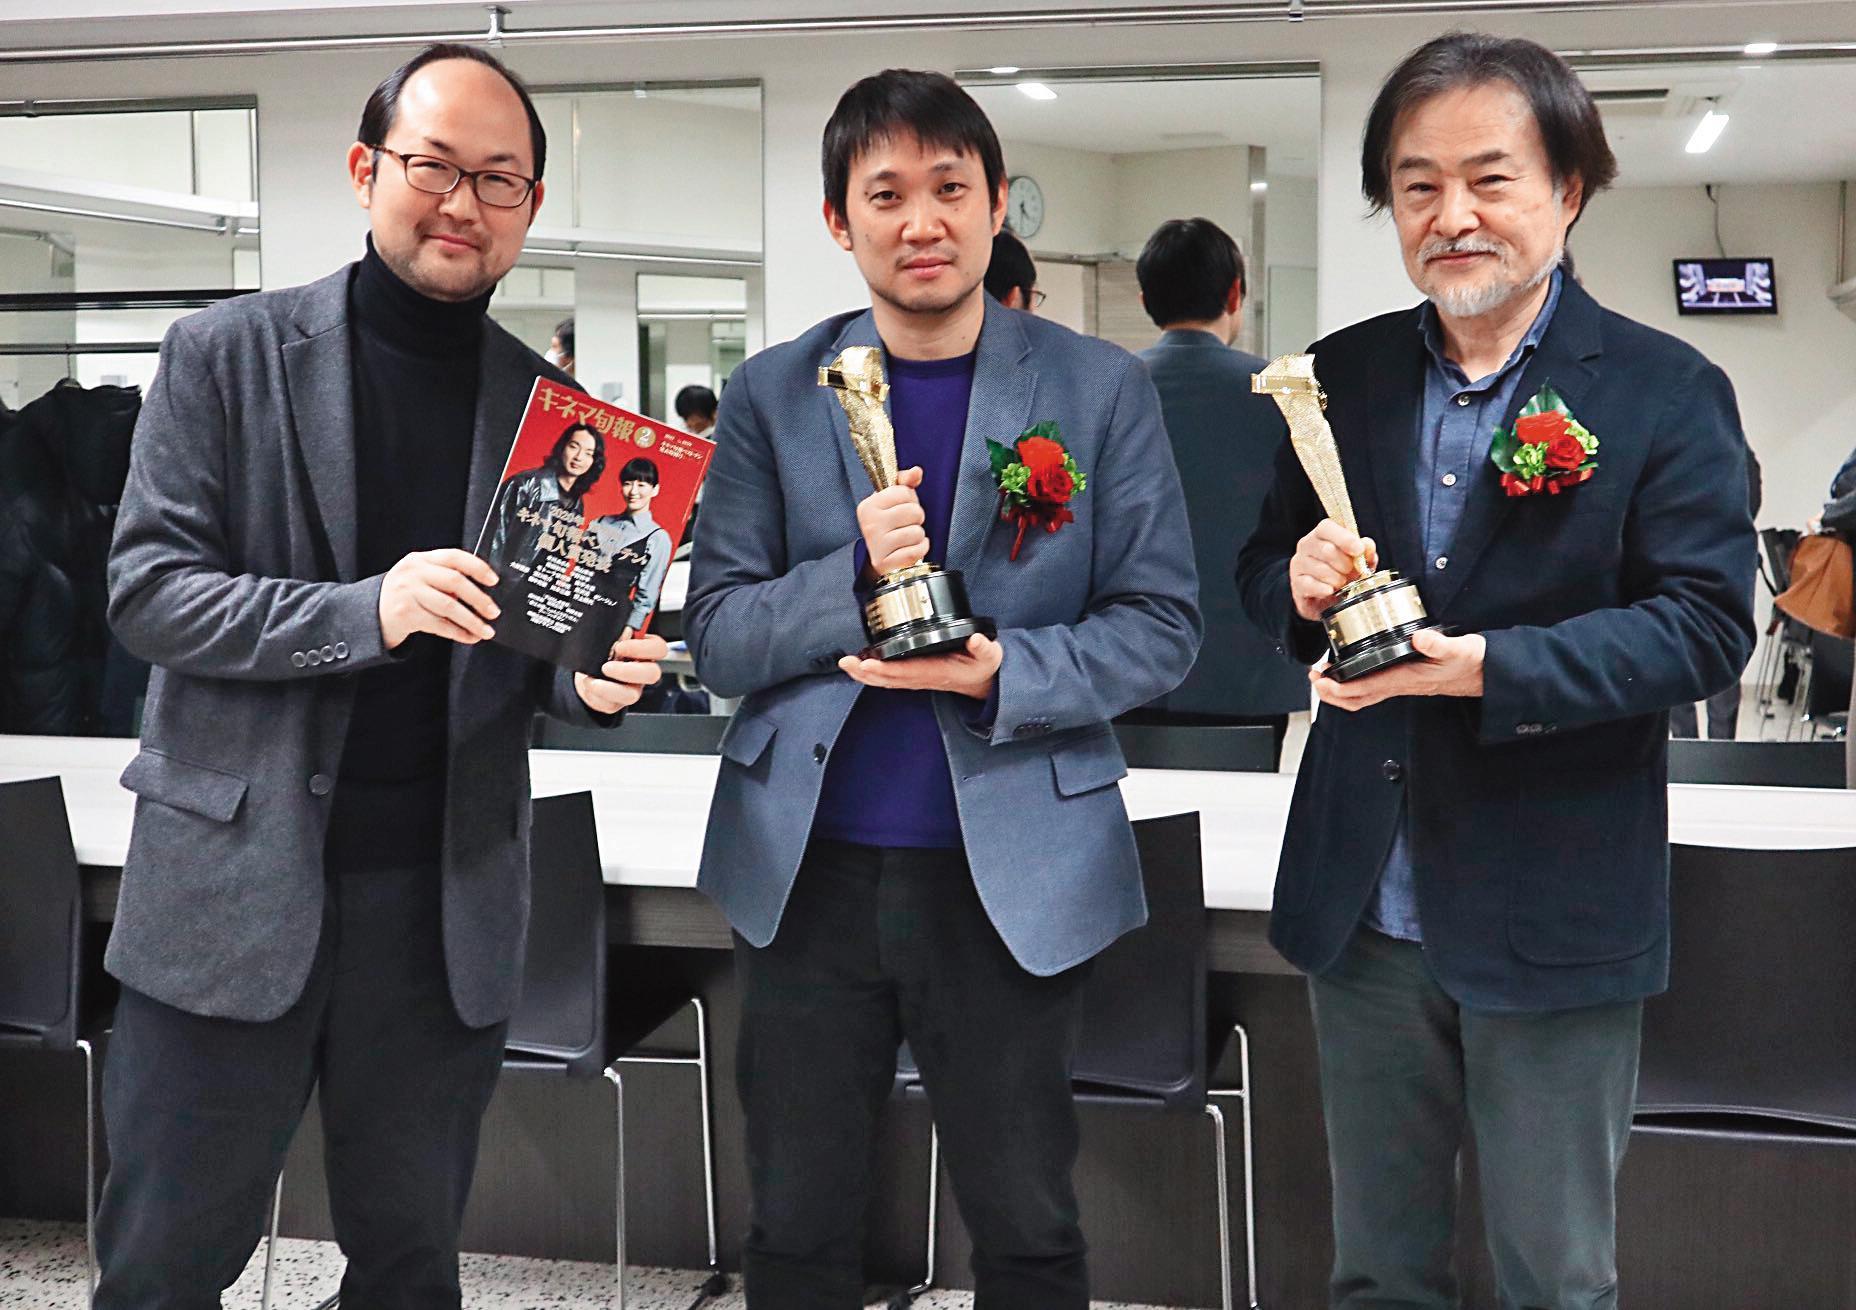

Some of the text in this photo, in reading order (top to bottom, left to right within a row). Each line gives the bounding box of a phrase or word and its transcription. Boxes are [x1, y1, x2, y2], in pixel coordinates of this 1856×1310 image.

[538, 387, 637, 443] キネマ旬報
[639, 430, 650, 443] 2
